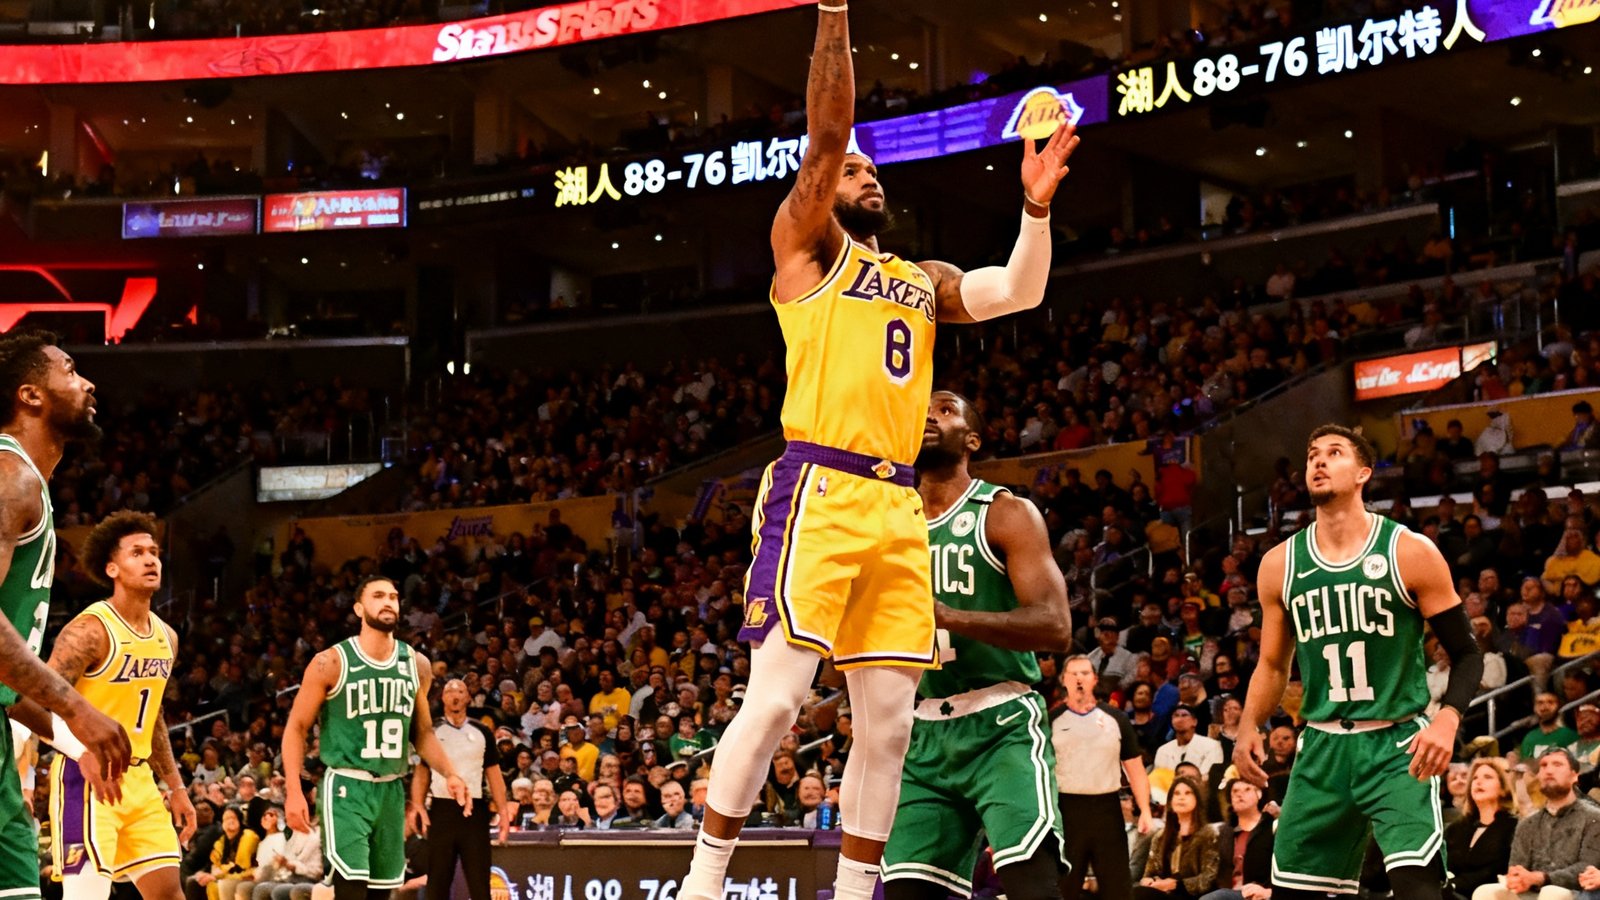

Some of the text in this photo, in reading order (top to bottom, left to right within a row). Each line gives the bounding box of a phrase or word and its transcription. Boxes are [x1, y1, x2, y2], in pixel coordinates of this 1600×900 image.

[1291, 582, 1394, 643] CELTICS
[1322, 641, 1375, 702] 11
[135, 688, 150, 732] 1
